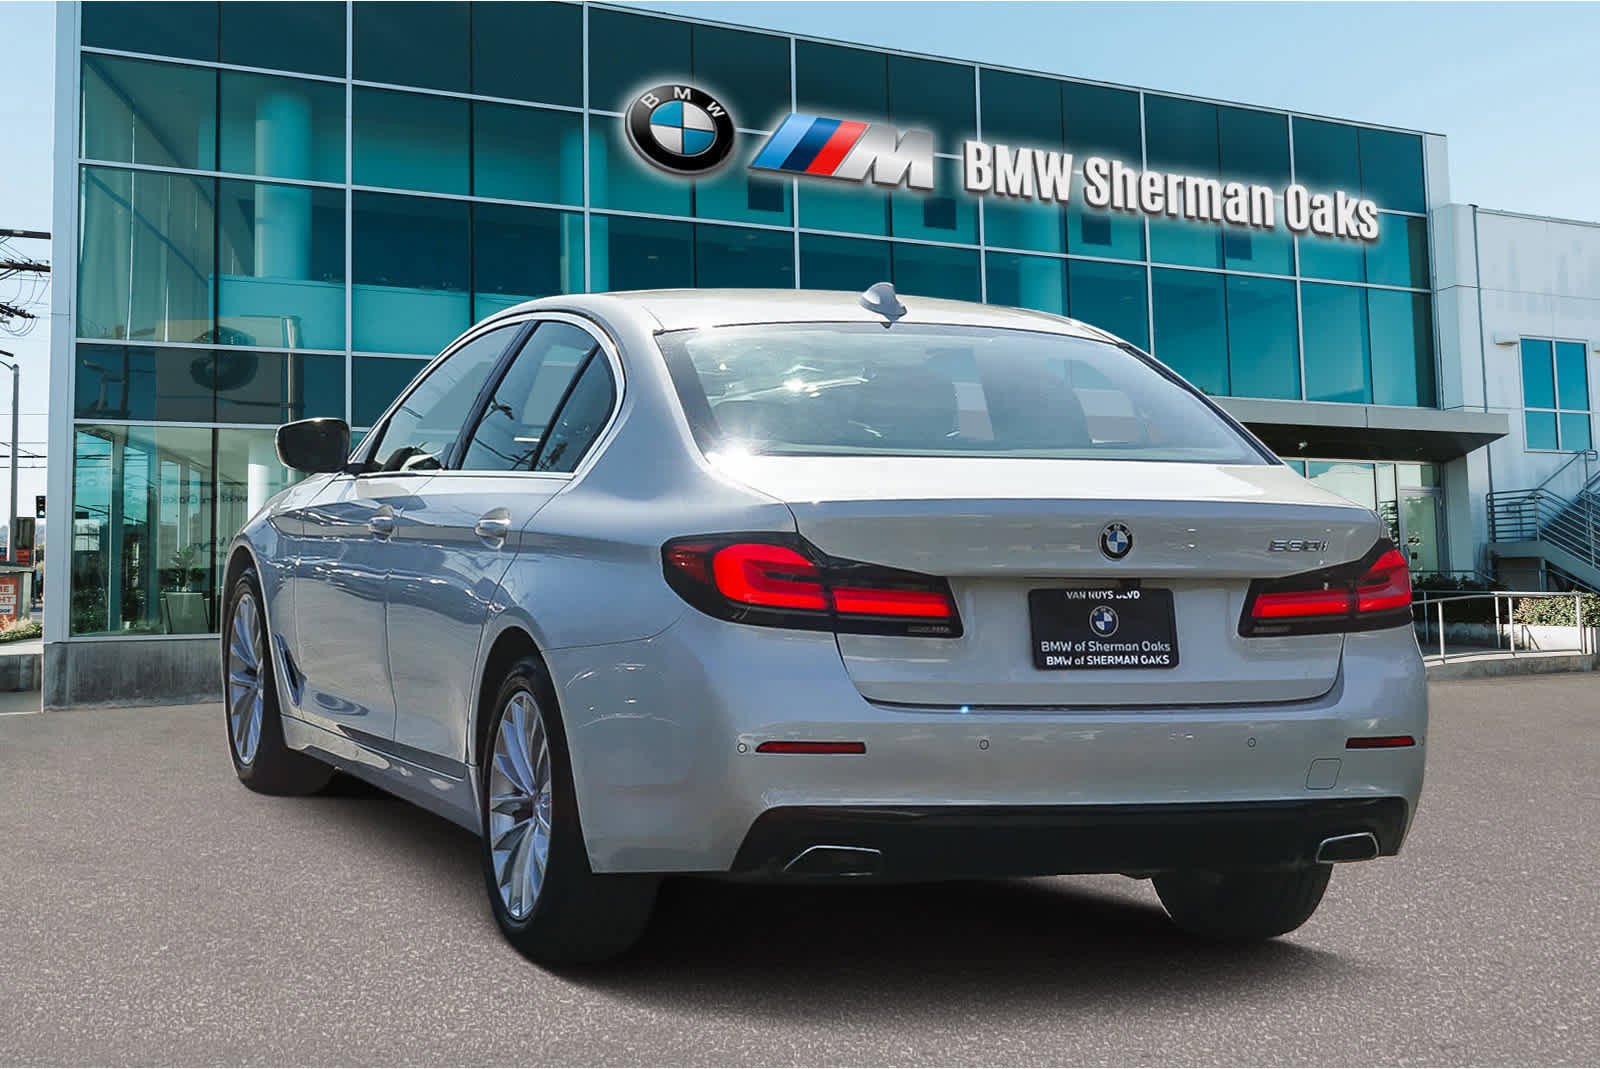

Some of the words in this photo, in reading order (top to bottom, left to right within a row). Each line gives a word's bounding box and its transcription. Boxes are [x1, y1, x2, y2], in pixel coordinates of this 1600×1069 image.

[640, 86, 725, 119] BMW
[964, 140, 1073, 201] BMW
[1083, 156, 1275, 228] Sherman
[1283, 183, 1380, 241] Oaks
[1066, 590, 1086, 599] VAN
[1088, 590, 1114, 599] NUYS
[1041, 641, 1072, 652] BMW
[1074, 641, 1087, 652] of
[1087, 641, 1139, 652] Sherman
[1141, 640, 1171, 652] Oaks
[1046, 656, 1073, 666] BMW
[1074, 656, 1085, 666] of
[1086, 655, 1139, 666] SHERMAN
[1140, 654, 1170, 666] OAKS
